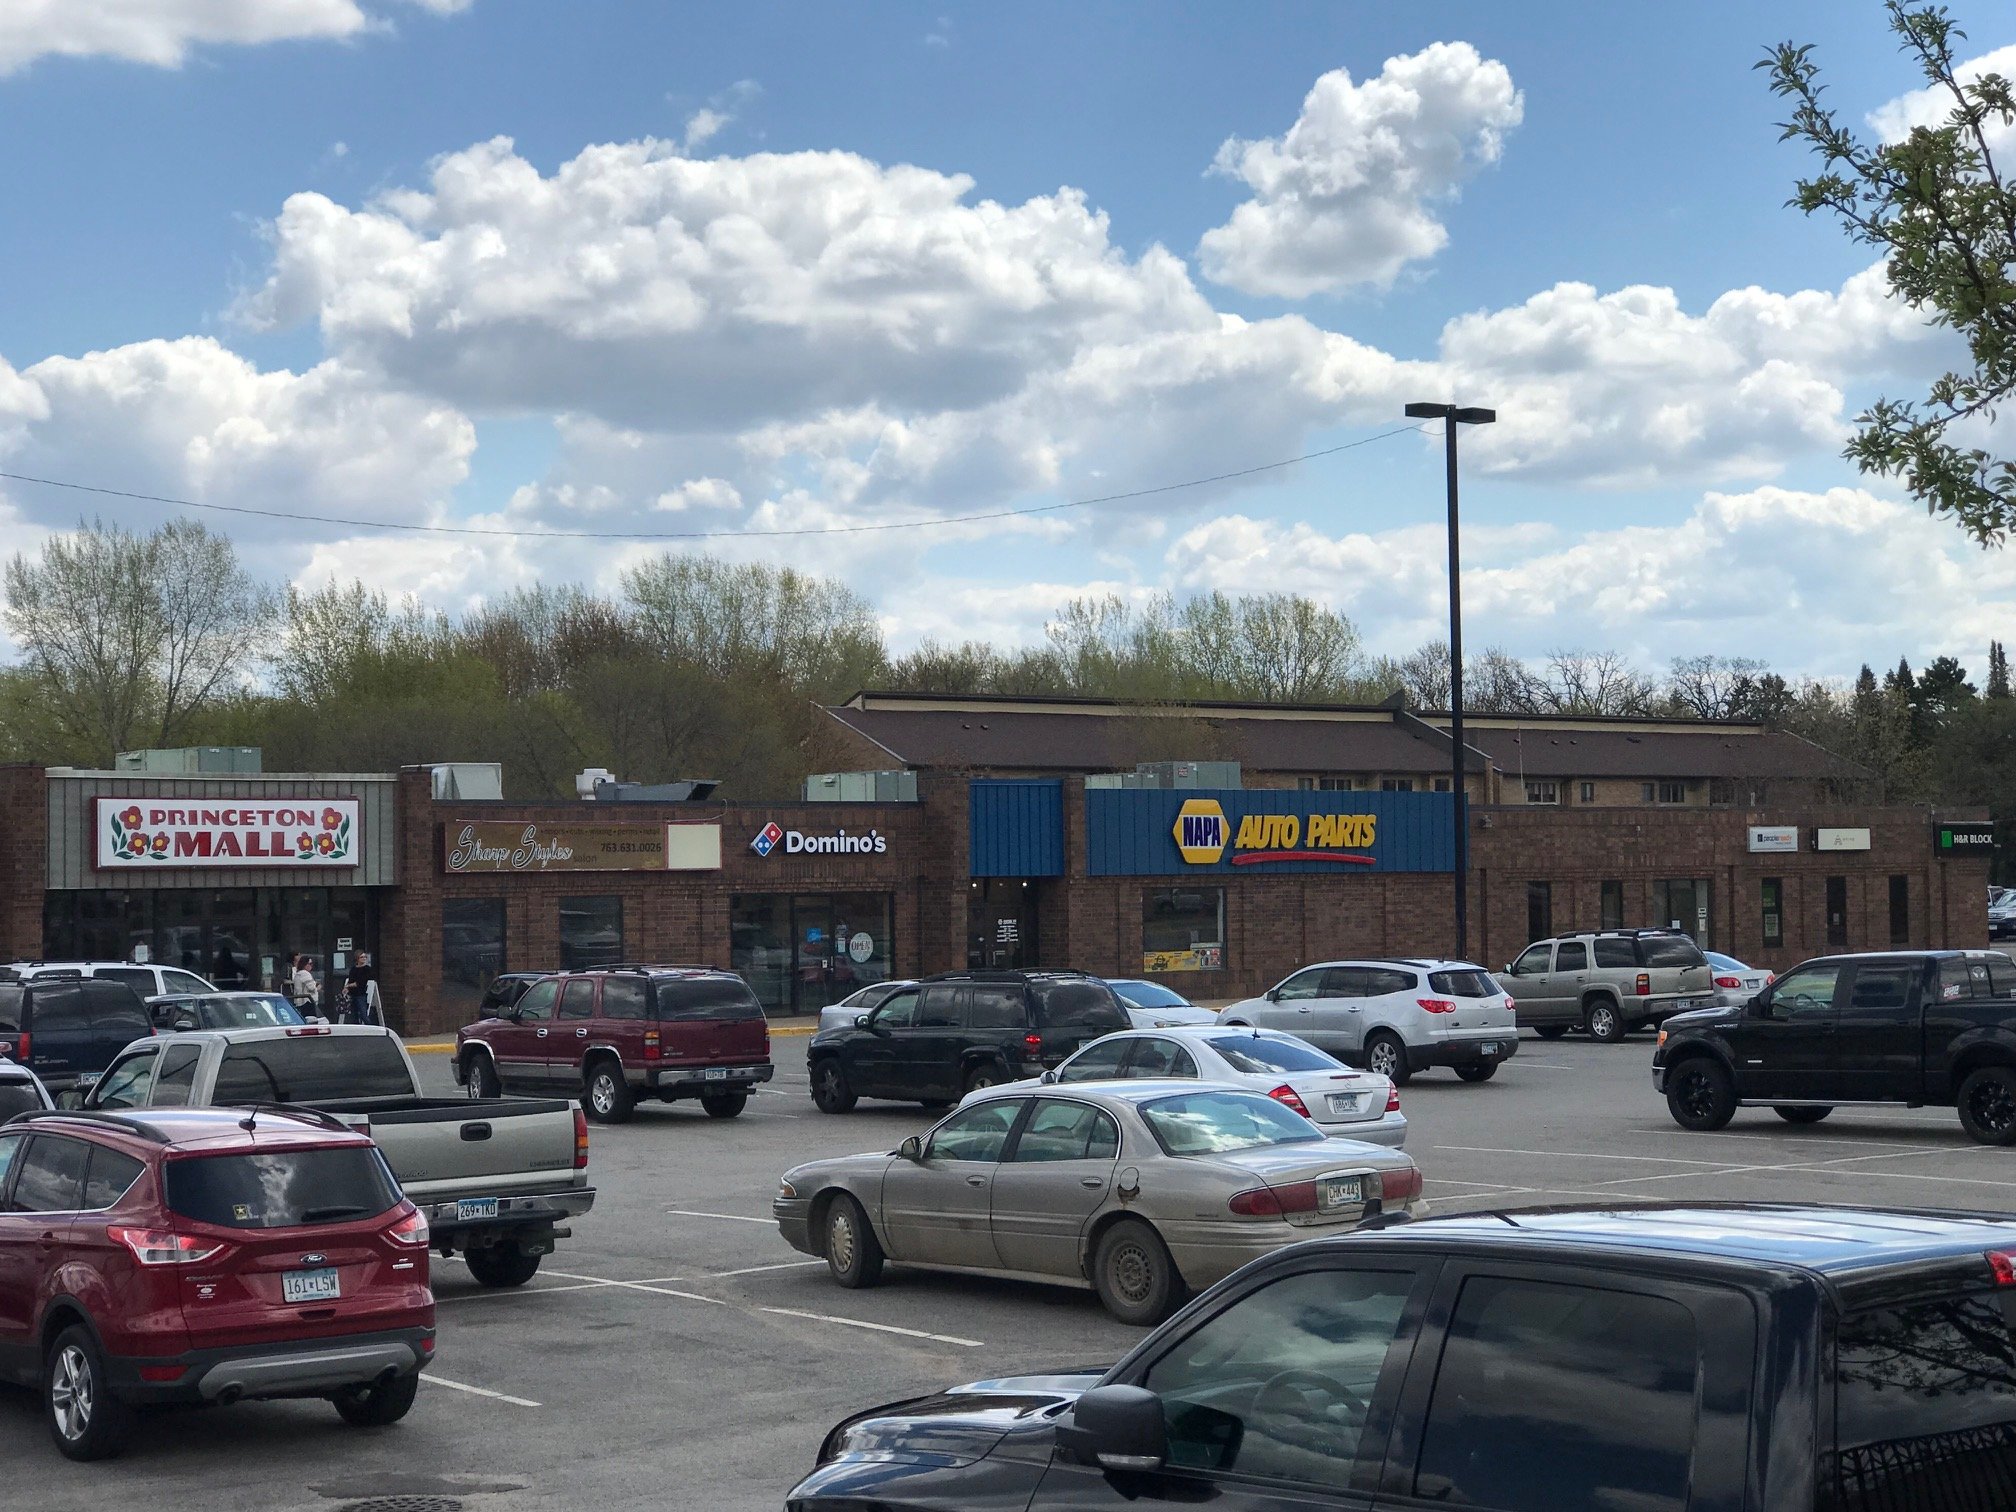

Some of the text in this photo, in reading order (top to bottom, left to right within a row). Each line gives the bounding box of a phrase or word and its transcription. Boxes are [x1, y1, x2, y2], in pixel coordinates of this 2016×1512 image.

[150, 809, 315, 826] PRINCETON
[786, 829, 887, 853] Domino's
[1183, 816, 1222, 847] NAPA
[1234, 814, 1377, 849] AUTO PARTS
[1953, 834, 1993, 843] H&R BLOCK
[174, 831, 296, 857] MALL
[449, 825, 573, 869] Sharp Styles
[600, 842, 662, 853] 763.631.0026
[851, 940, 871, 951] OPEN
